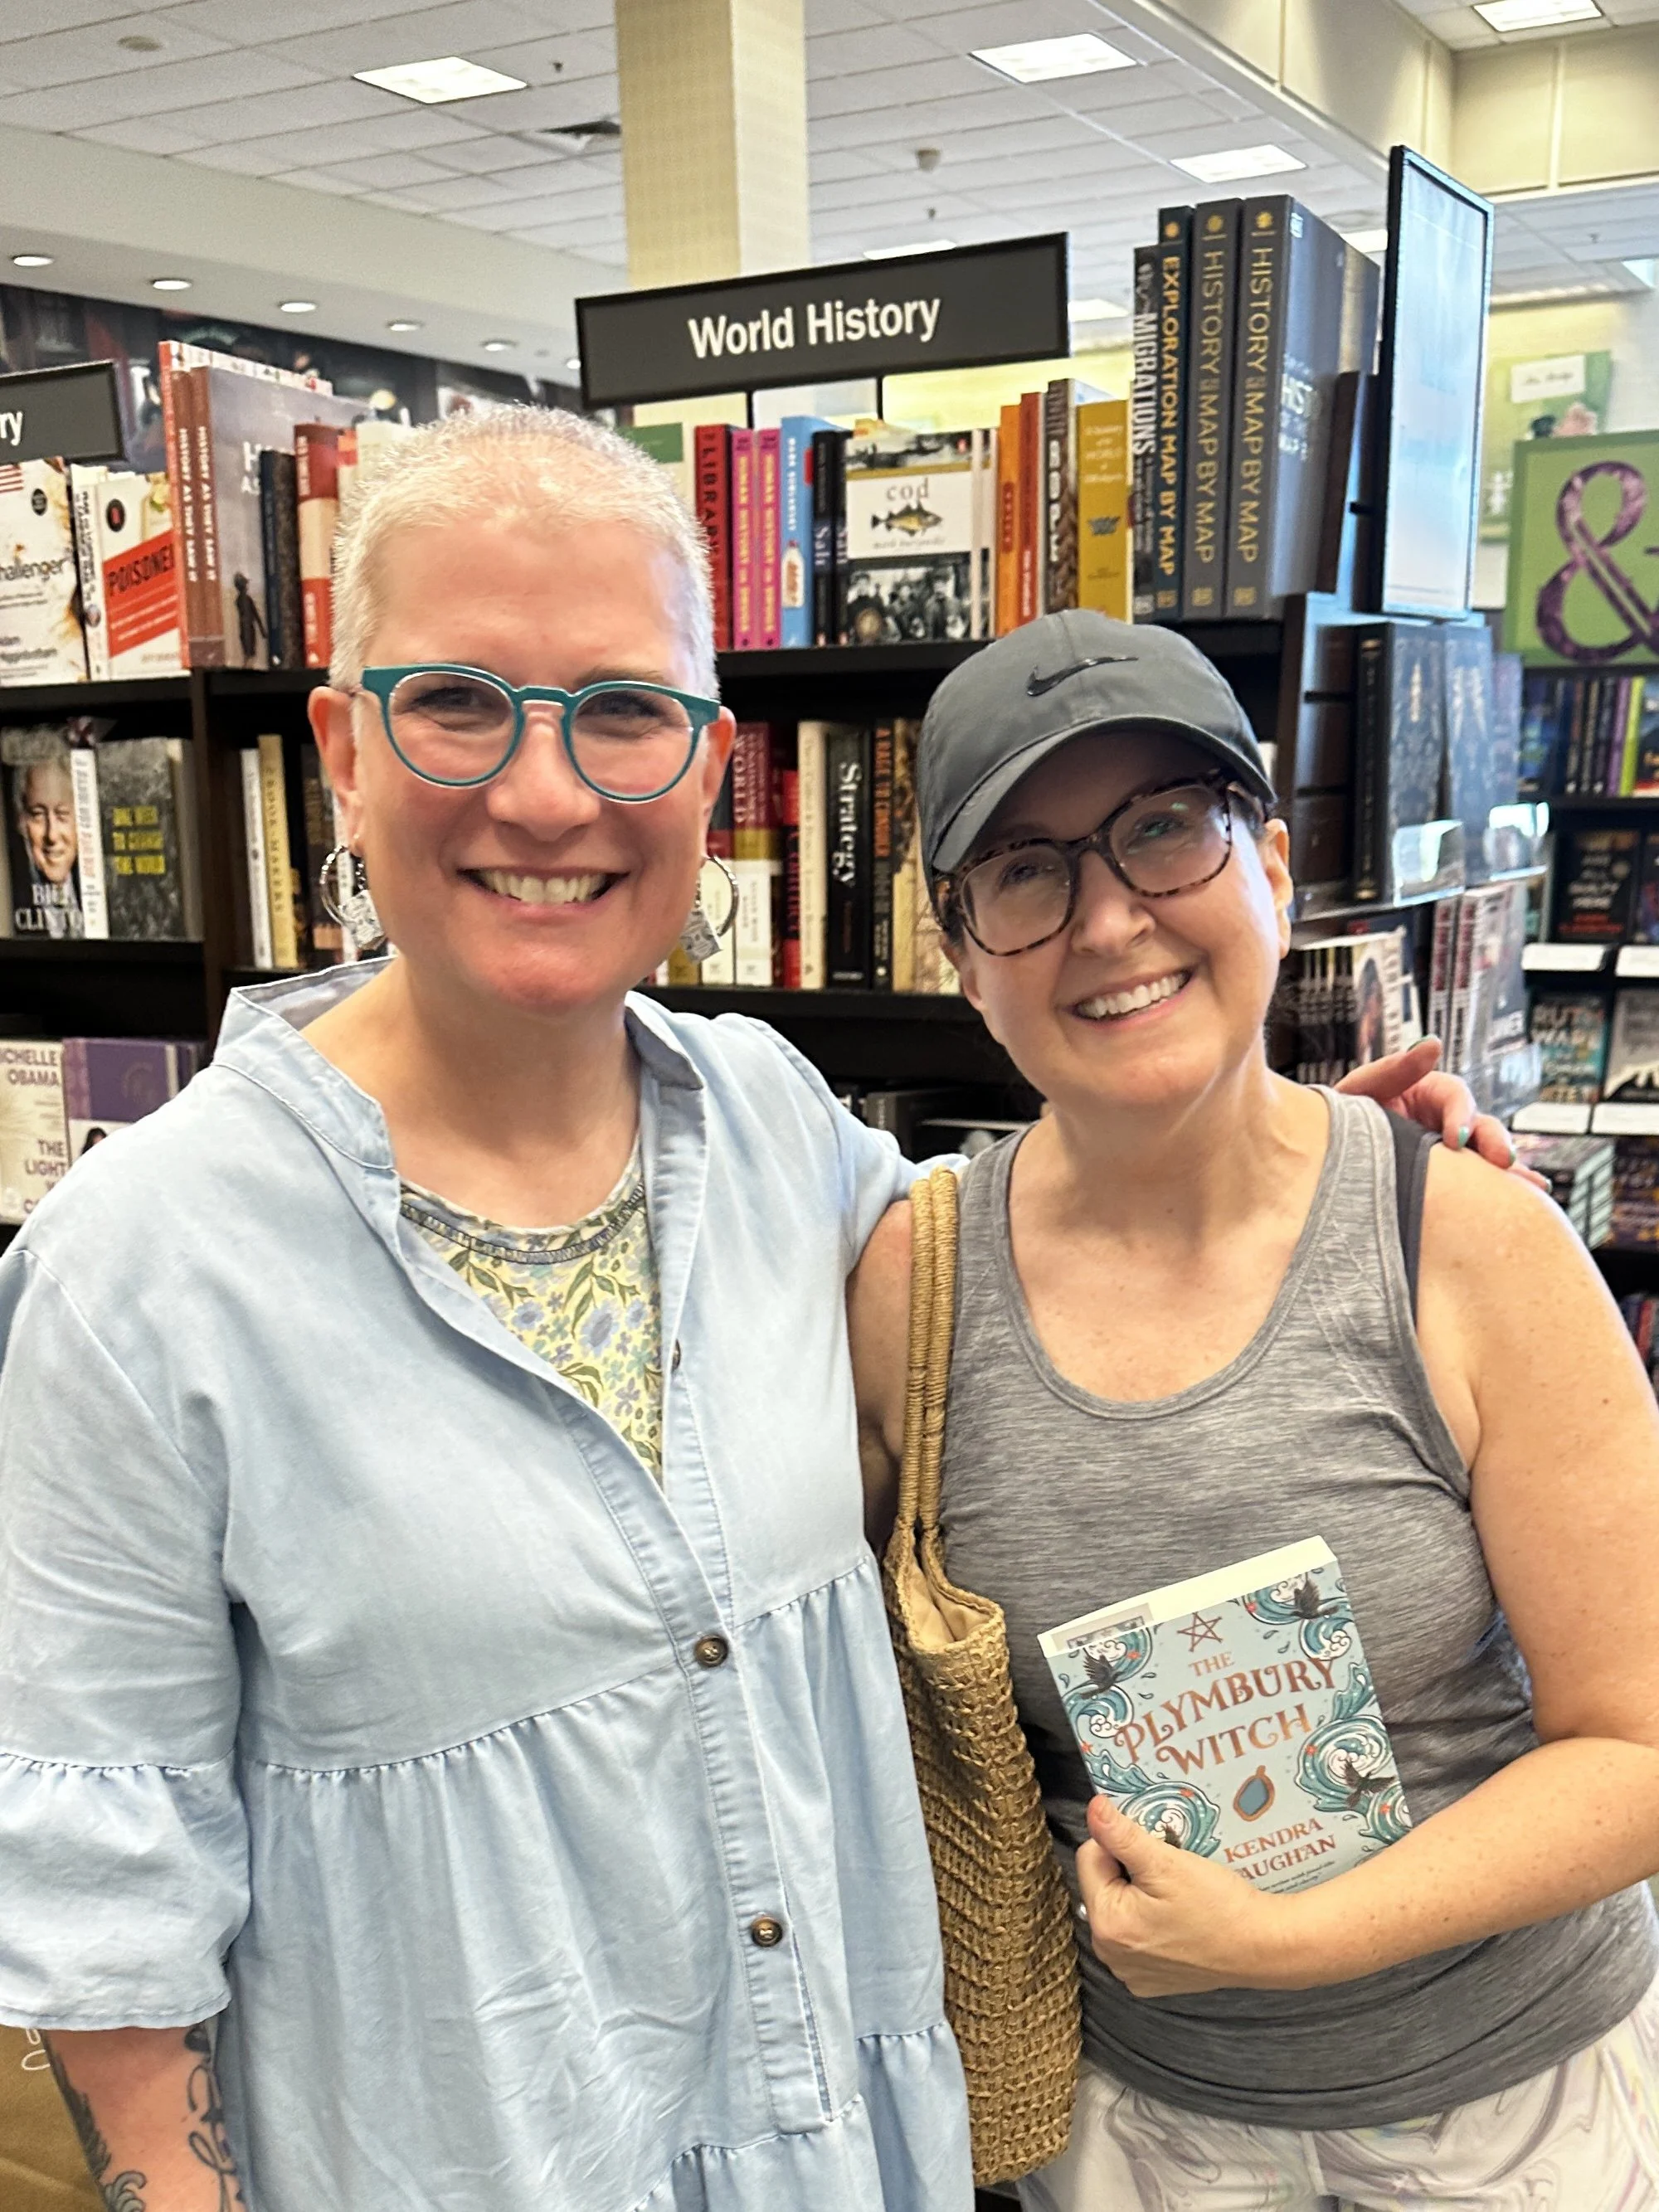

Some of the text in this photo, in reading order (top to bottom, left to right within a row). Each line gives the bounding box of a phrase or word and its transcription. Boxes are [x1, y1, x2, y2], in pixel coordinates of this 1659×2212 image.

[688, 298, 941, 358] World History
[1200, 250, 1226, 374] HISTORY
[1247, 247, 1273, 372] HISTORY
[1133, 313, 1157, 455] MIGRATIONS
[1159, 255, 1180, 576] EXPLORATION MAP BY MAP
[1197, 394, 1220, 455] MAP
[1242, 392, 1266, 455] MAP
[179, 428, 197, 582] HISTORY AS THEY SAW IT
[198, 426, 216, 581] HISTORY AS THEY SAW IT
[887, 478, 928, 500] cod
[1195, 460, 1219, 496] BY
[1240, 459, 1263, 494] BY
[815, 526, 831, 566] Salt
[1194, 501, 1215, 564] MAP
[1238, 500, 1261, 562] MAP
[109, 544, 174, 596] POISONE
[734, 733, 747, 824] WORLD
[831, 761, 863, 887] Strategy
[15, 907, 84, 931] CLINTO
[32, 883, 71, 907] BILL
[8, 1068, 59, 1086] OBAMA
[25, 1162, 66, 1176] LIGHT
[38, 1139, 64, 1157] THE
[1189, 1651, 1236, 1677] THE
[1114, 1659, 1336, 1763] PLYMBURY
[1156, 1703, 1312, 1776] WITCH
[1223, 1818, 1323, 1864] KENDRA
[1234, 1834, 1336, 1880] AUGHAN
